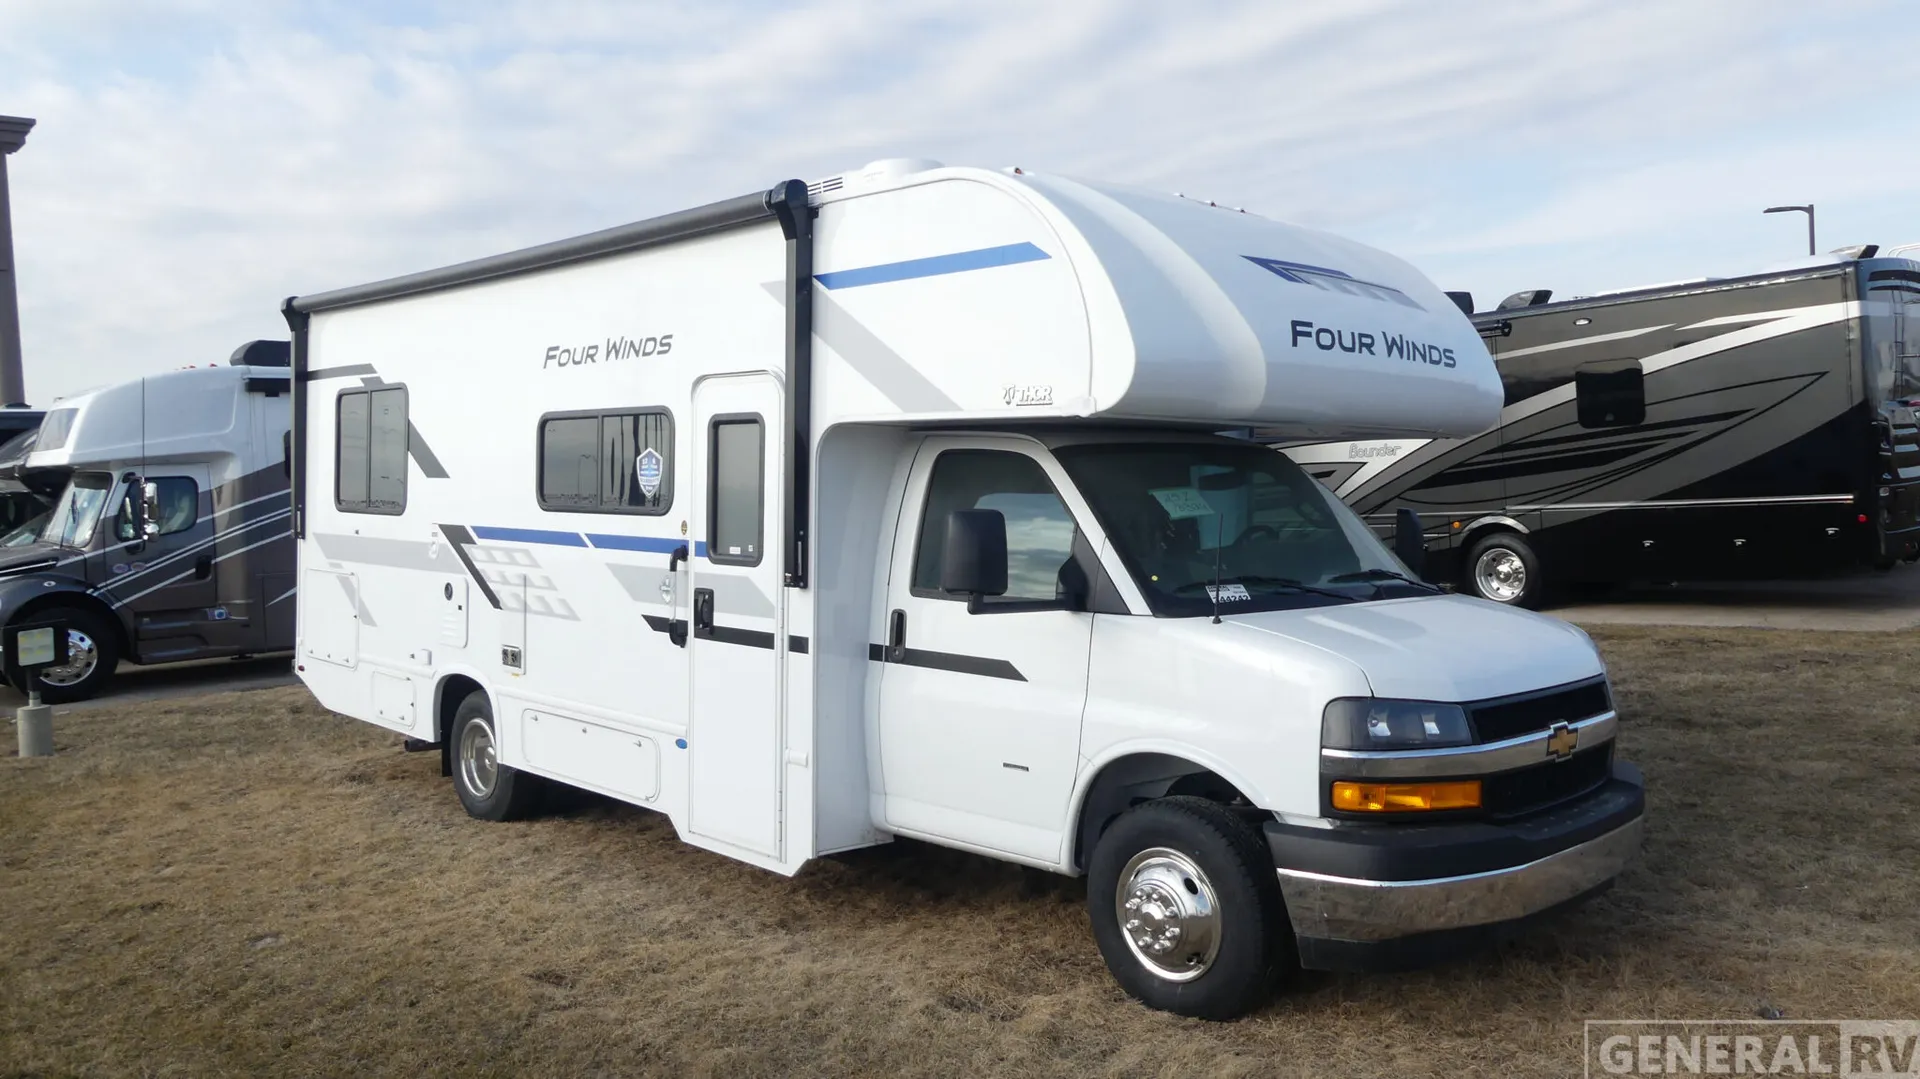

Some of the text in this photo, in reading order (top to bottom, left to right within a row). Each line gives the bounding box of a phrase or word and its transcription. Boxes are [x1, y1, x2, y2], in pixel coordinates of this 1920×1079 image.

[543, 334, 673, 369] FOUR WINDS
[1291, 320, 1456, 368] FOUR WINDS
[1349, 443, 1402, 459] Bounder
